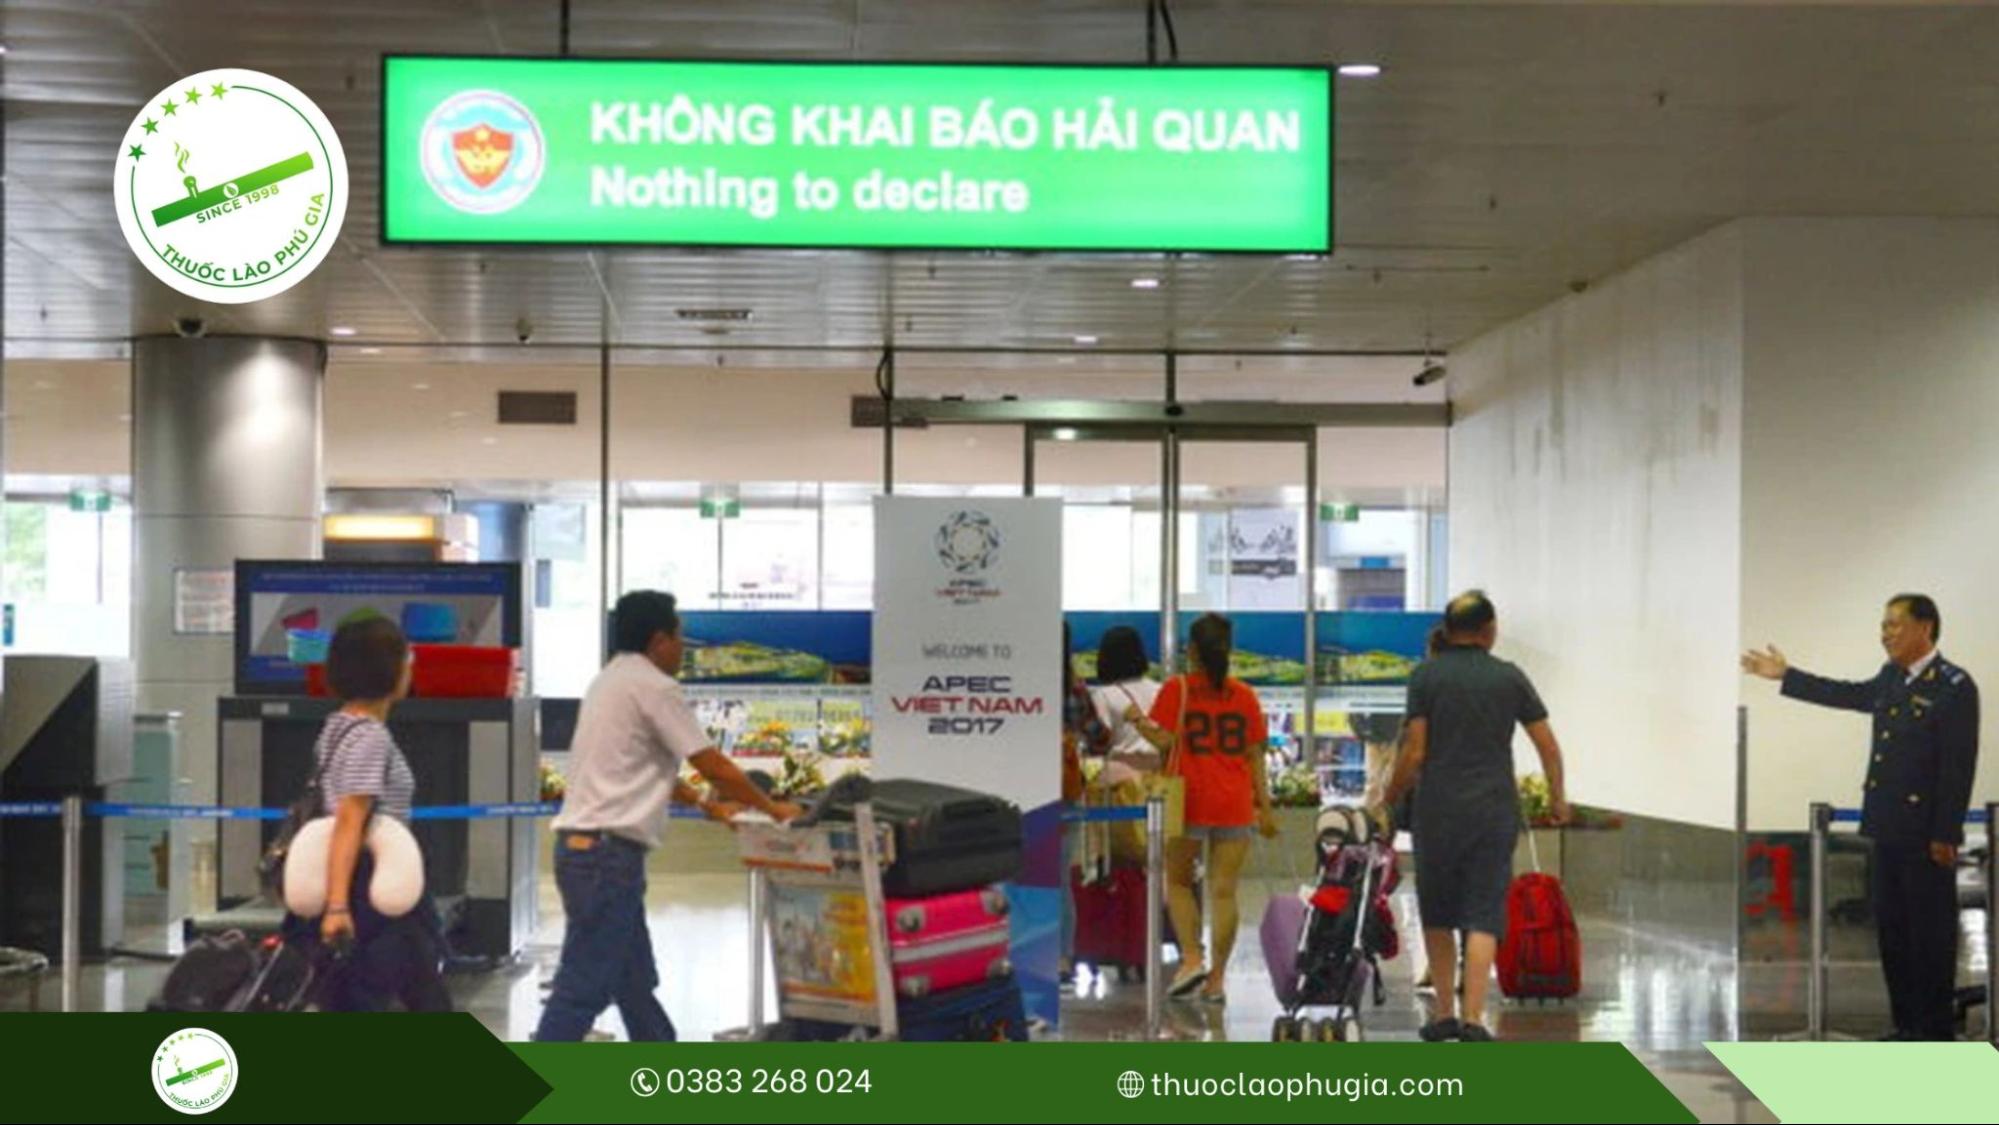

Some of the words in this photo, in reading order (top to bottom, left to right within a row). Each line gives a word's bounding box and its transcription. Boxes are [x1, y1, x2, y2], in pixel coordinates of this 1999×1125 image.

[590, 93, 775, 145] KHÔNG
[791, 104, 914, 147] KHAI
[929, 98, 1038, 149] BÁO
[1052, 97, 1139, 150] HẢI
[1152, 108, 1300, 152] QUAN
[590, 165, 778, 218] Nothing
[793, 173, 839, 209] to
[852, 169, 1031, 213] declare
[922, 644, 988, 660] WELCOME
[993, 644, 1012, 660] TO
[922, 676, 1012, 693] APEC
[928, 718, 1004, 735] 2017
[1184, 709, 1246, 755] 28
